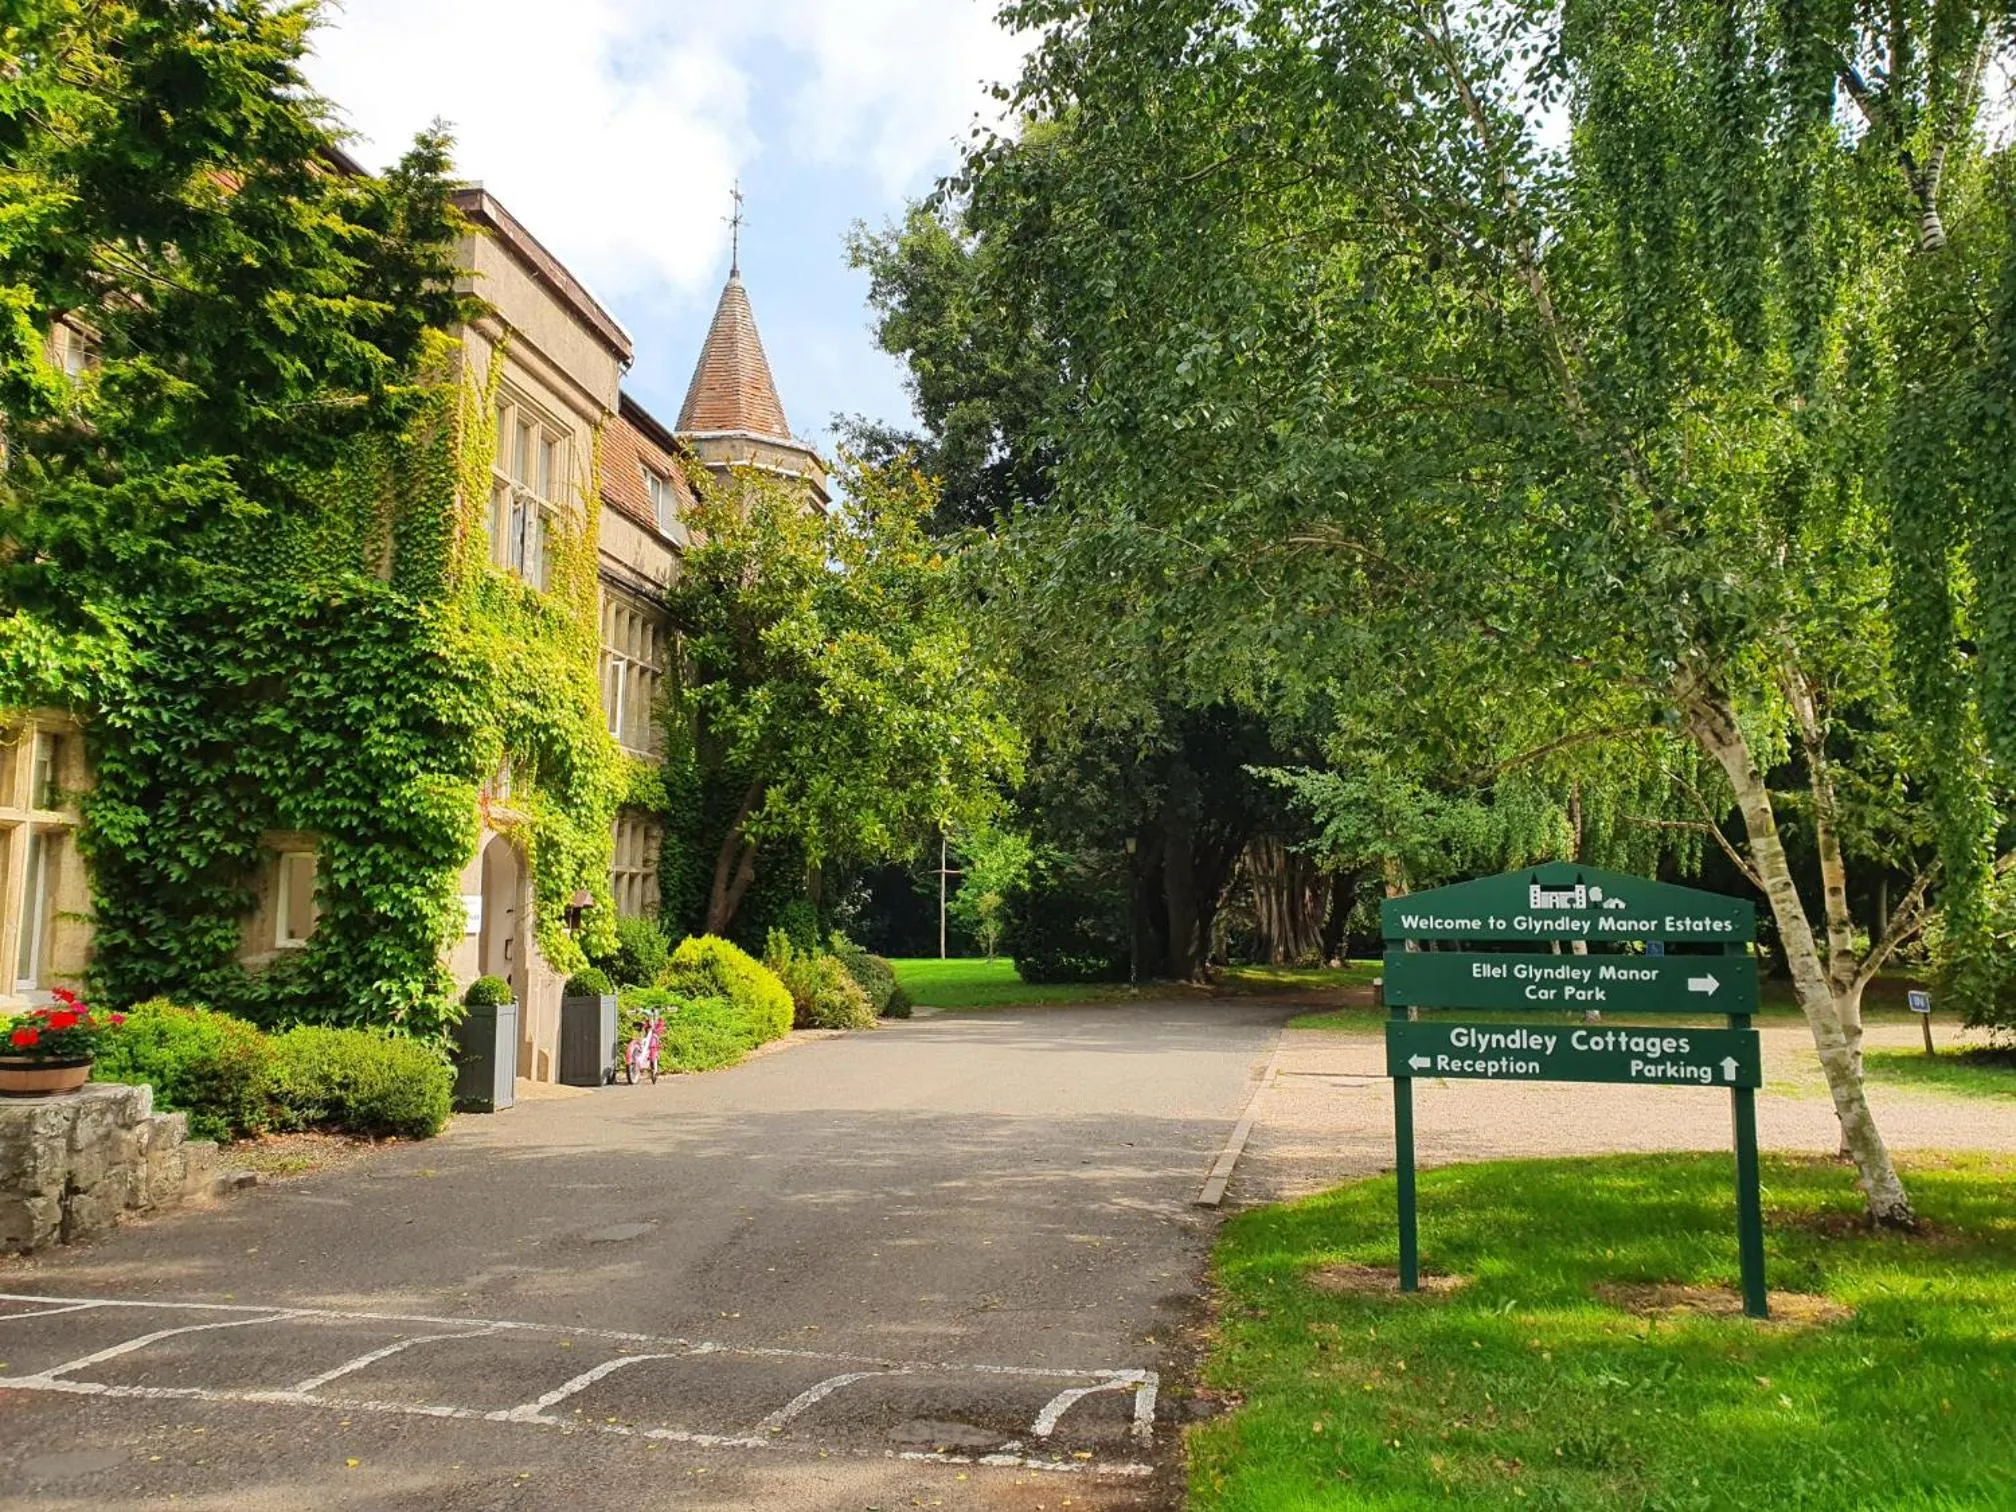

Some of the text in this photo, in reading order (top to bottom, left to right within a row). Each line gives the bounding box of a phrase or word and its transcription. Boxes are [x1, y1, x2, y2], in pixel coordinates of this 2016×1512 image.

[1400, 914, 1733, 935] Welcome to Glyndley Manor Estates
[1472, 962, 1659, 983] Ellel Glyndley Manor
[1525, 985, 1606, 1001] Car Park
[1450, 1027, 1691, 1057] Glyndley Cottages
[1436, 1054, 1540, 1076] Reception
[1630, 1060, 1712, 1084] Parking
